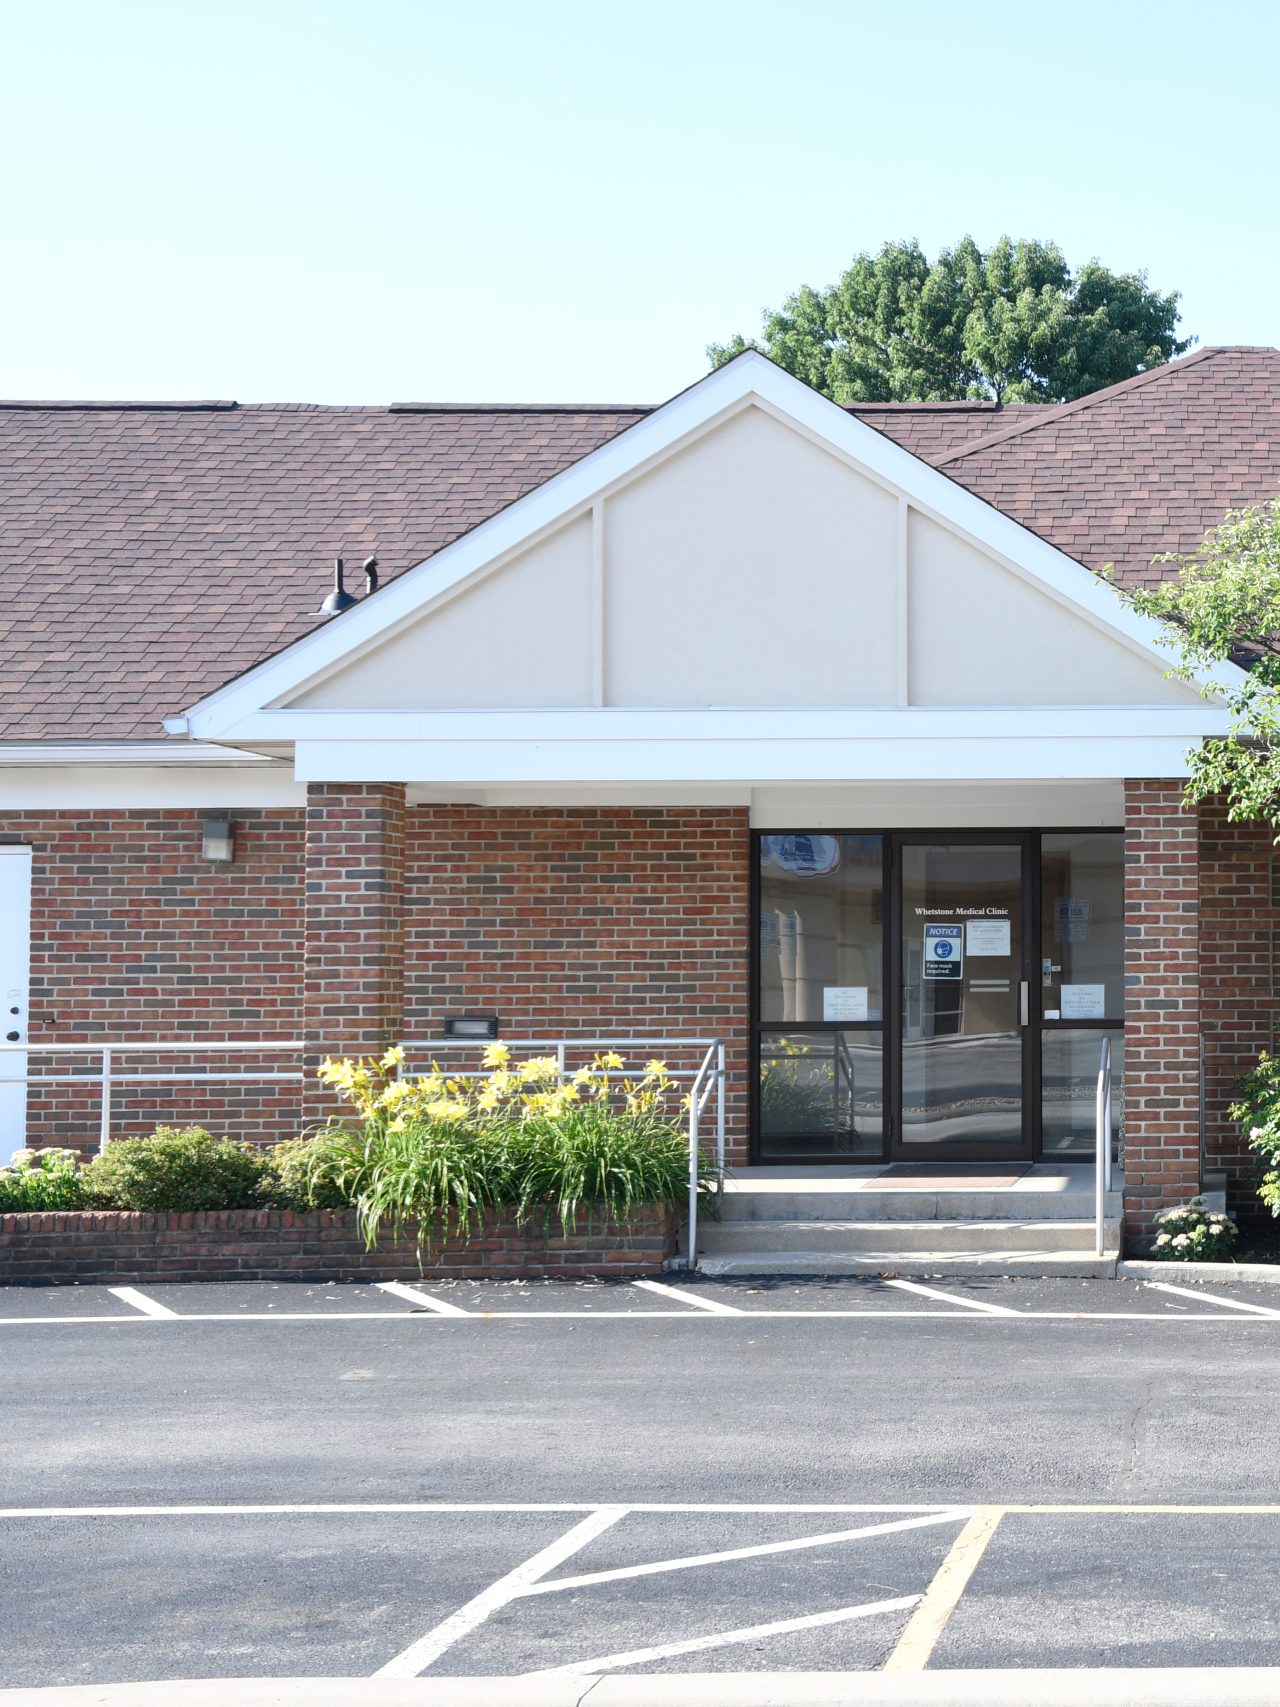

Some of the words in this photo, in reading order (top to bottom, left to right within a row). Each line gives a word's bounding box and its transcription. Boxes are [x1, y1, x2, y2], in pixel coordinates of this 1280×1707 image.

[915, 907, 954, 915] Whetstone
[955, 907, 985, 915] Medical
[986, 907, 1008, 915] Clinic
[929, 928, 958, 936] NOTICE
